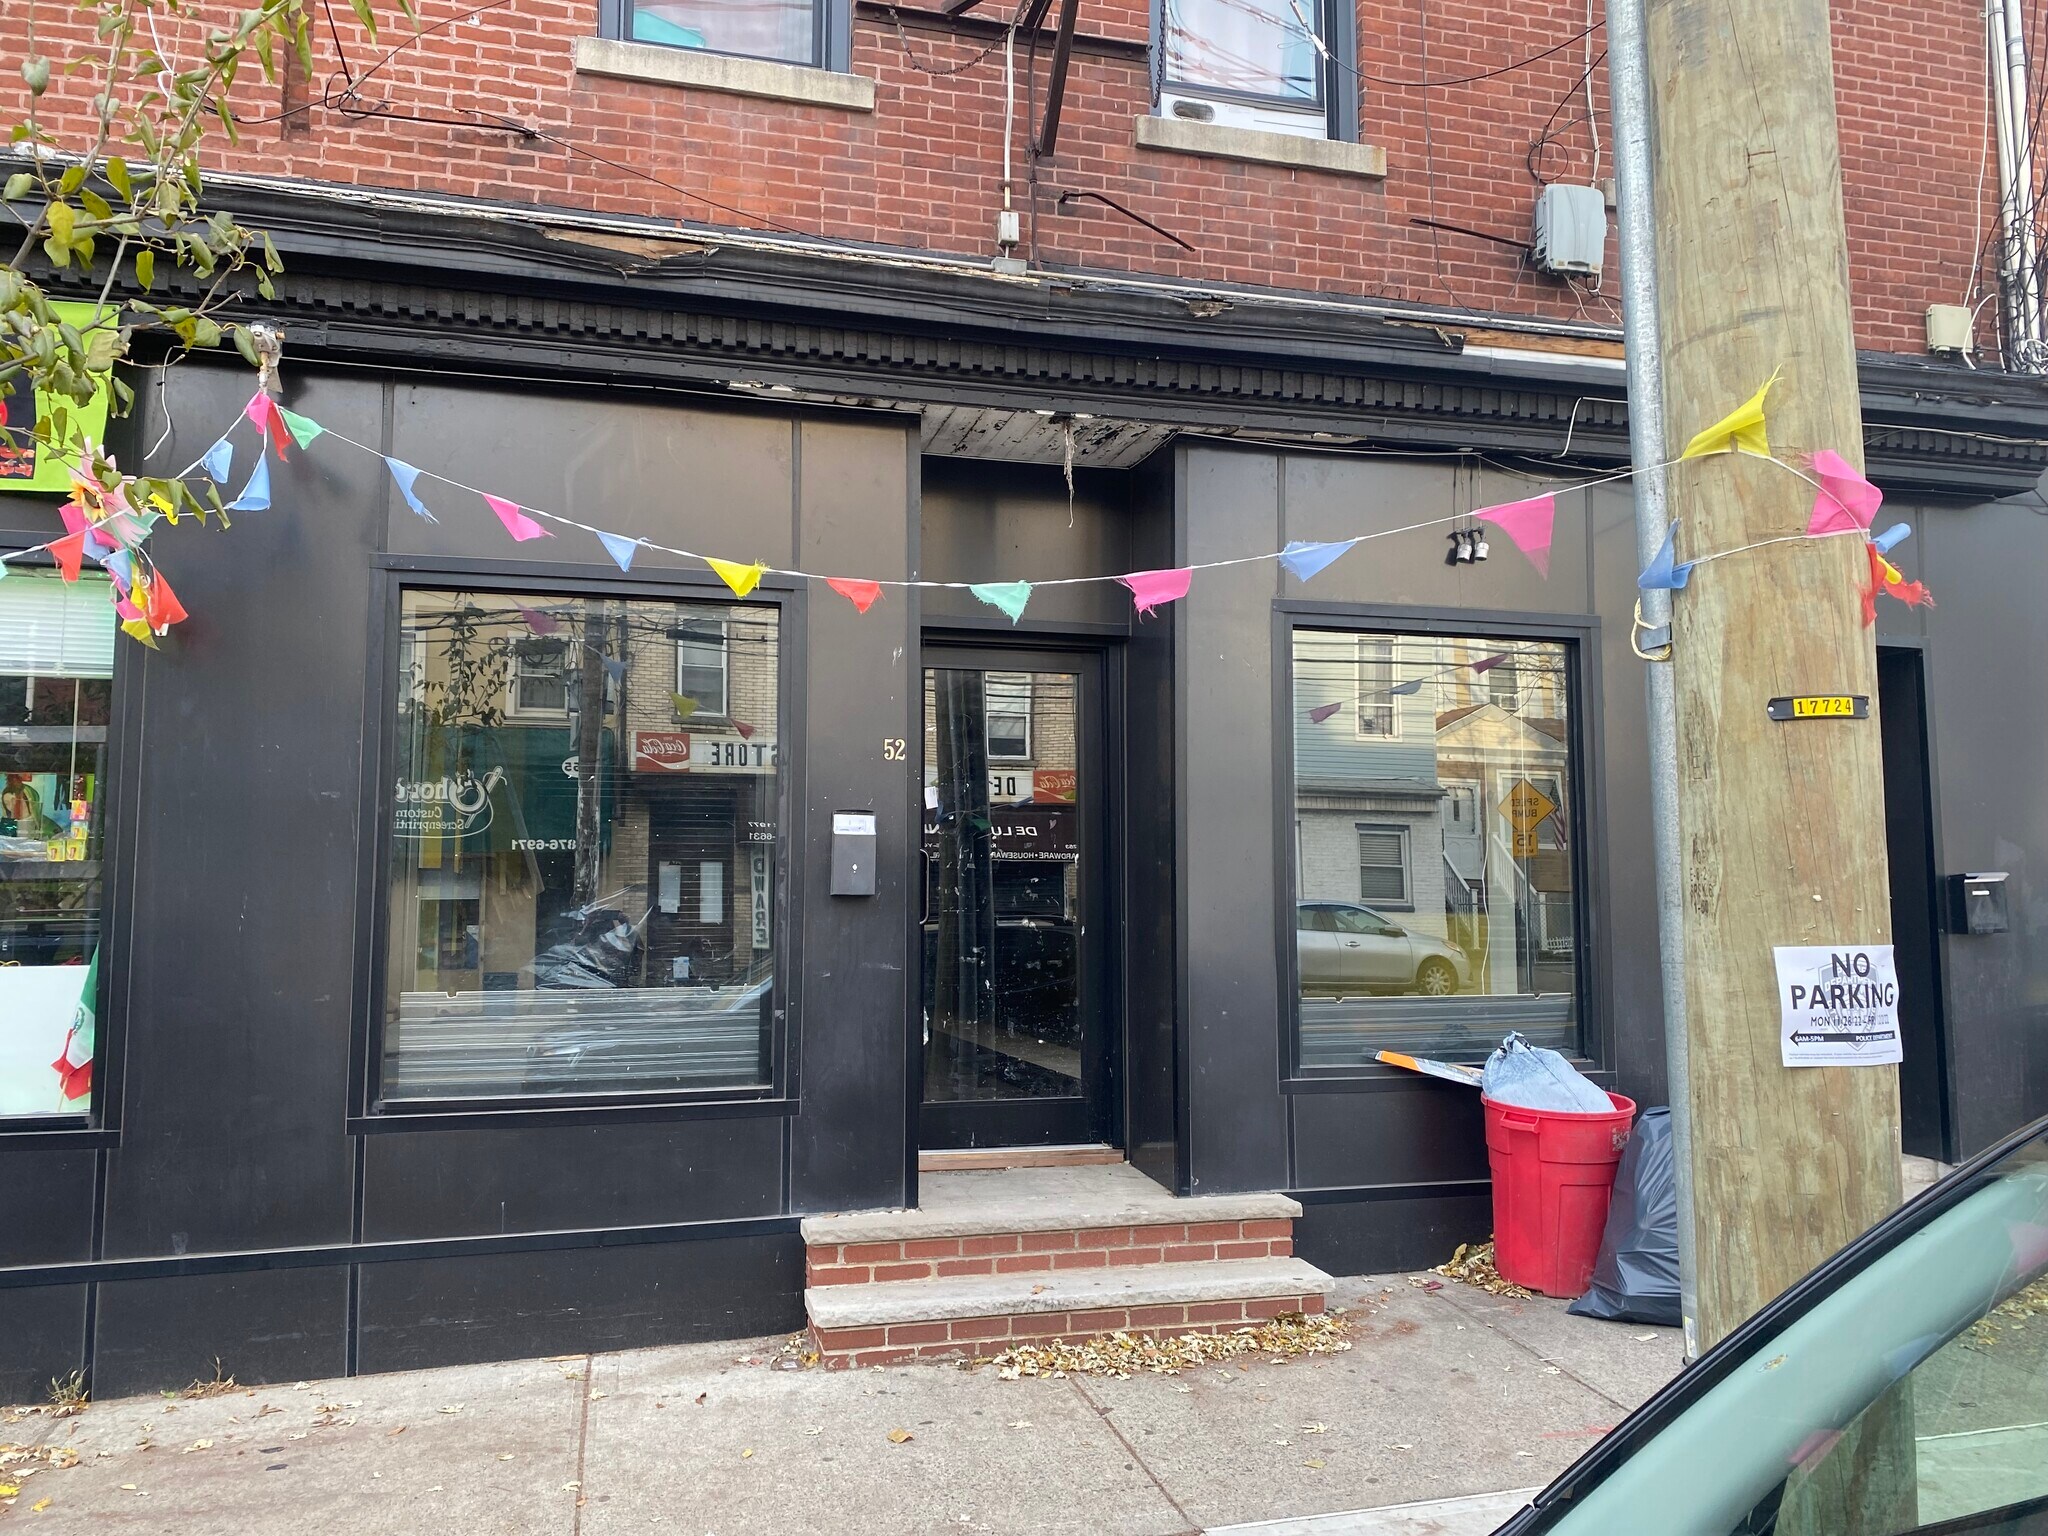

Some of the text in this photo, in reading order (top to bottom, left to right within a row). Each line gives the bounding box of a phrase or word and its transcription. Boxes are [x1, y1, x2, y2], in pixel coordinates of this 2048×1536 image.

[1797, 699, 1851, 714] 17724
[883, 738, 906, 760] 52
[1831, 952, 1870, 978] NO
[1790, 982, 1894, 1010] PARKING
[1810, 1016, 1830, 1027] MON
